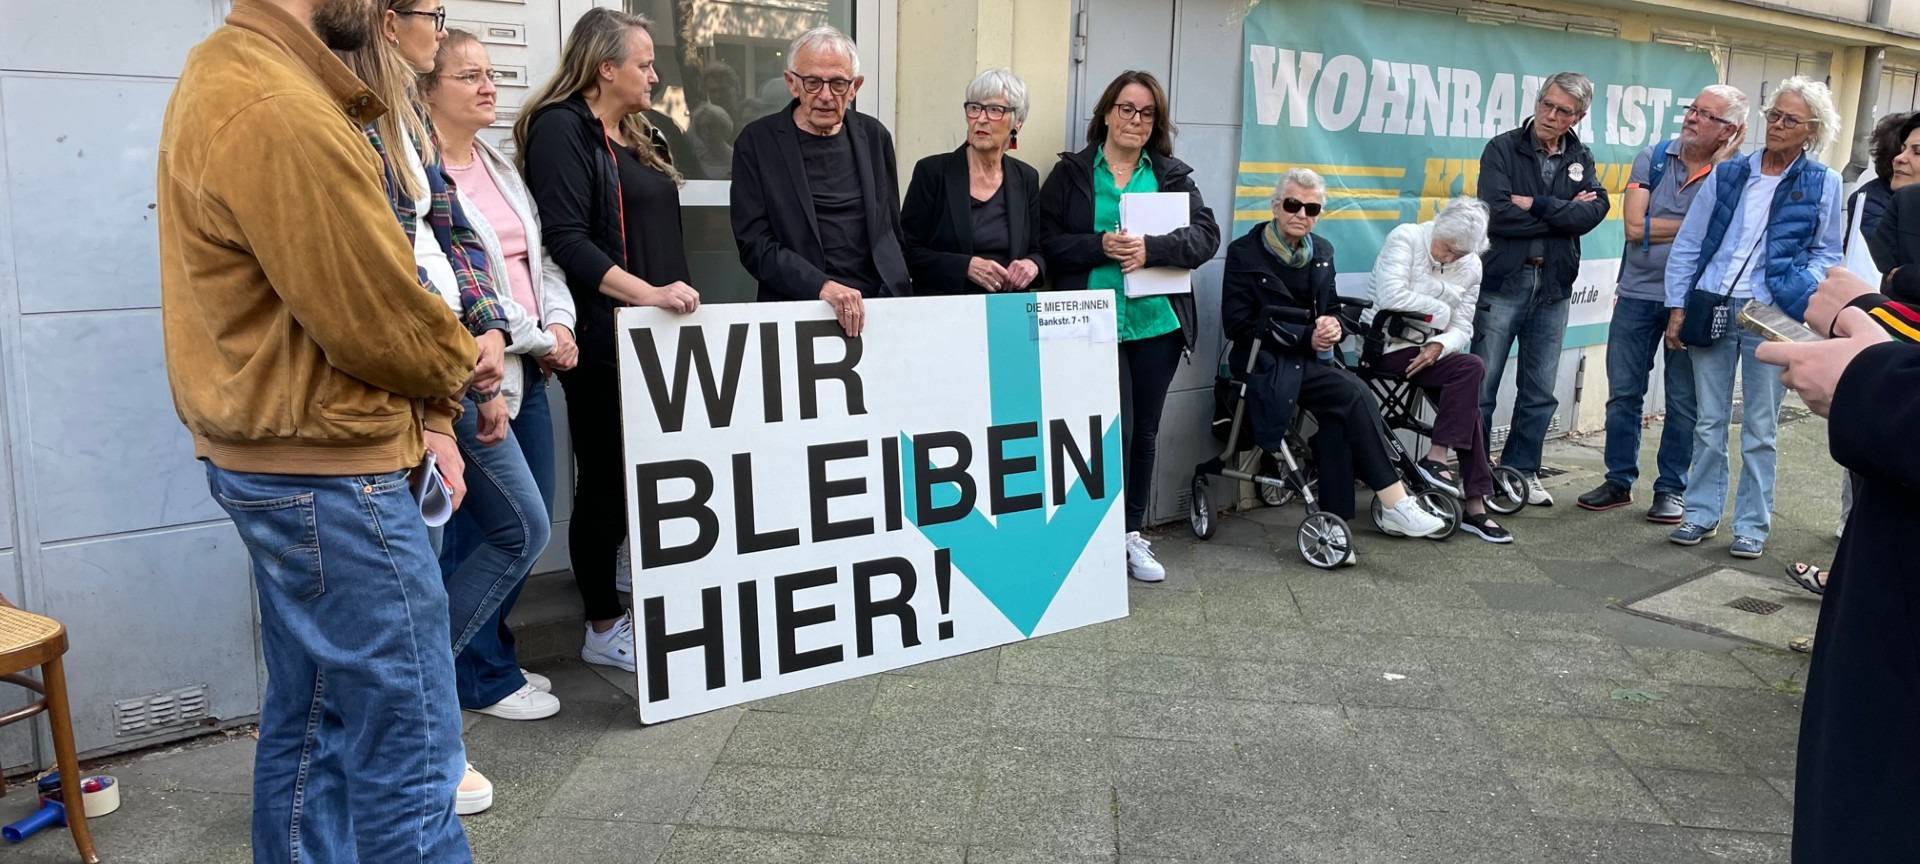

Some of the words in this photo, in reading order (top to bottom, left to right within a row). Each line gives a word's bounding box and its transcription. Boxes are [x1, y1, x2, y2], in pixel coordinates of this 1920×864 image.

[1605, 84, 1672, 147] IST
[1026, 302, 1042, 313] DIE
[1044, 300, 1108, 312] MIETER:INNEN
[1039, 317, 1071, 327] Bankstr.
[1072, 316, 1077, 324] 7
[1082, 316, 1090, 324] 11
[1571, 285, 1599, 305] orf.de
[628, 319, 868, 434] WIR
[635, 415, 1106, 570] BLEIBEN
[643, 548, 955, 703] HIER!
